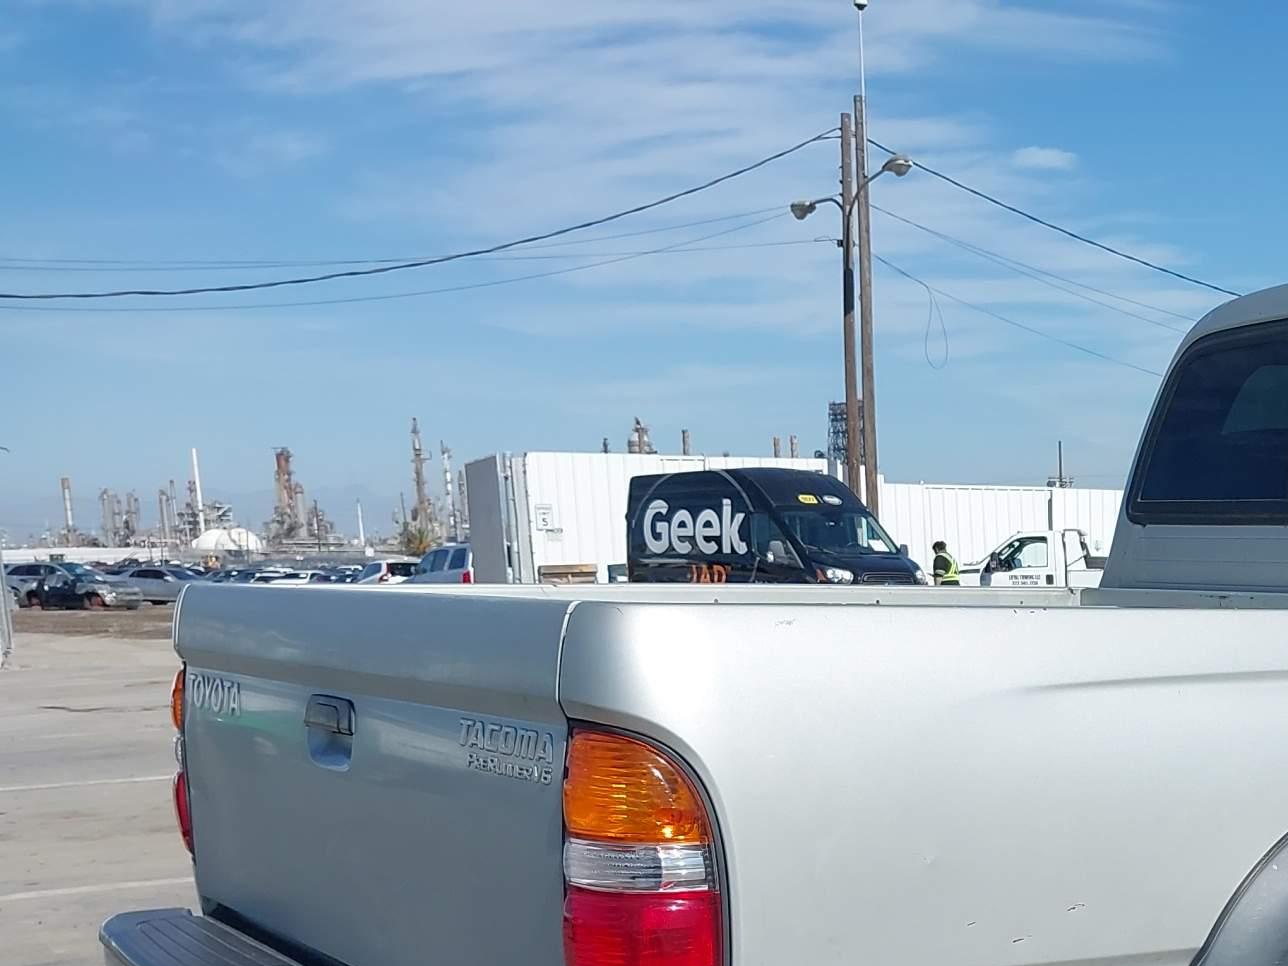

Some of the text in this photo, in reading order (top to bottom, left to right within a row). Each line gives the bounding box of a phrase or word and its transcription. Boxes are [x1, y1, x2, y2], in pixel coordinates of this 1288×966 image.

[643, 498, 748, 554] Geek
[189, 673, 241, 717] TOYOTA
[460, 717, 554, 765] TACOMA
[532, 763, 553, 786] V6
